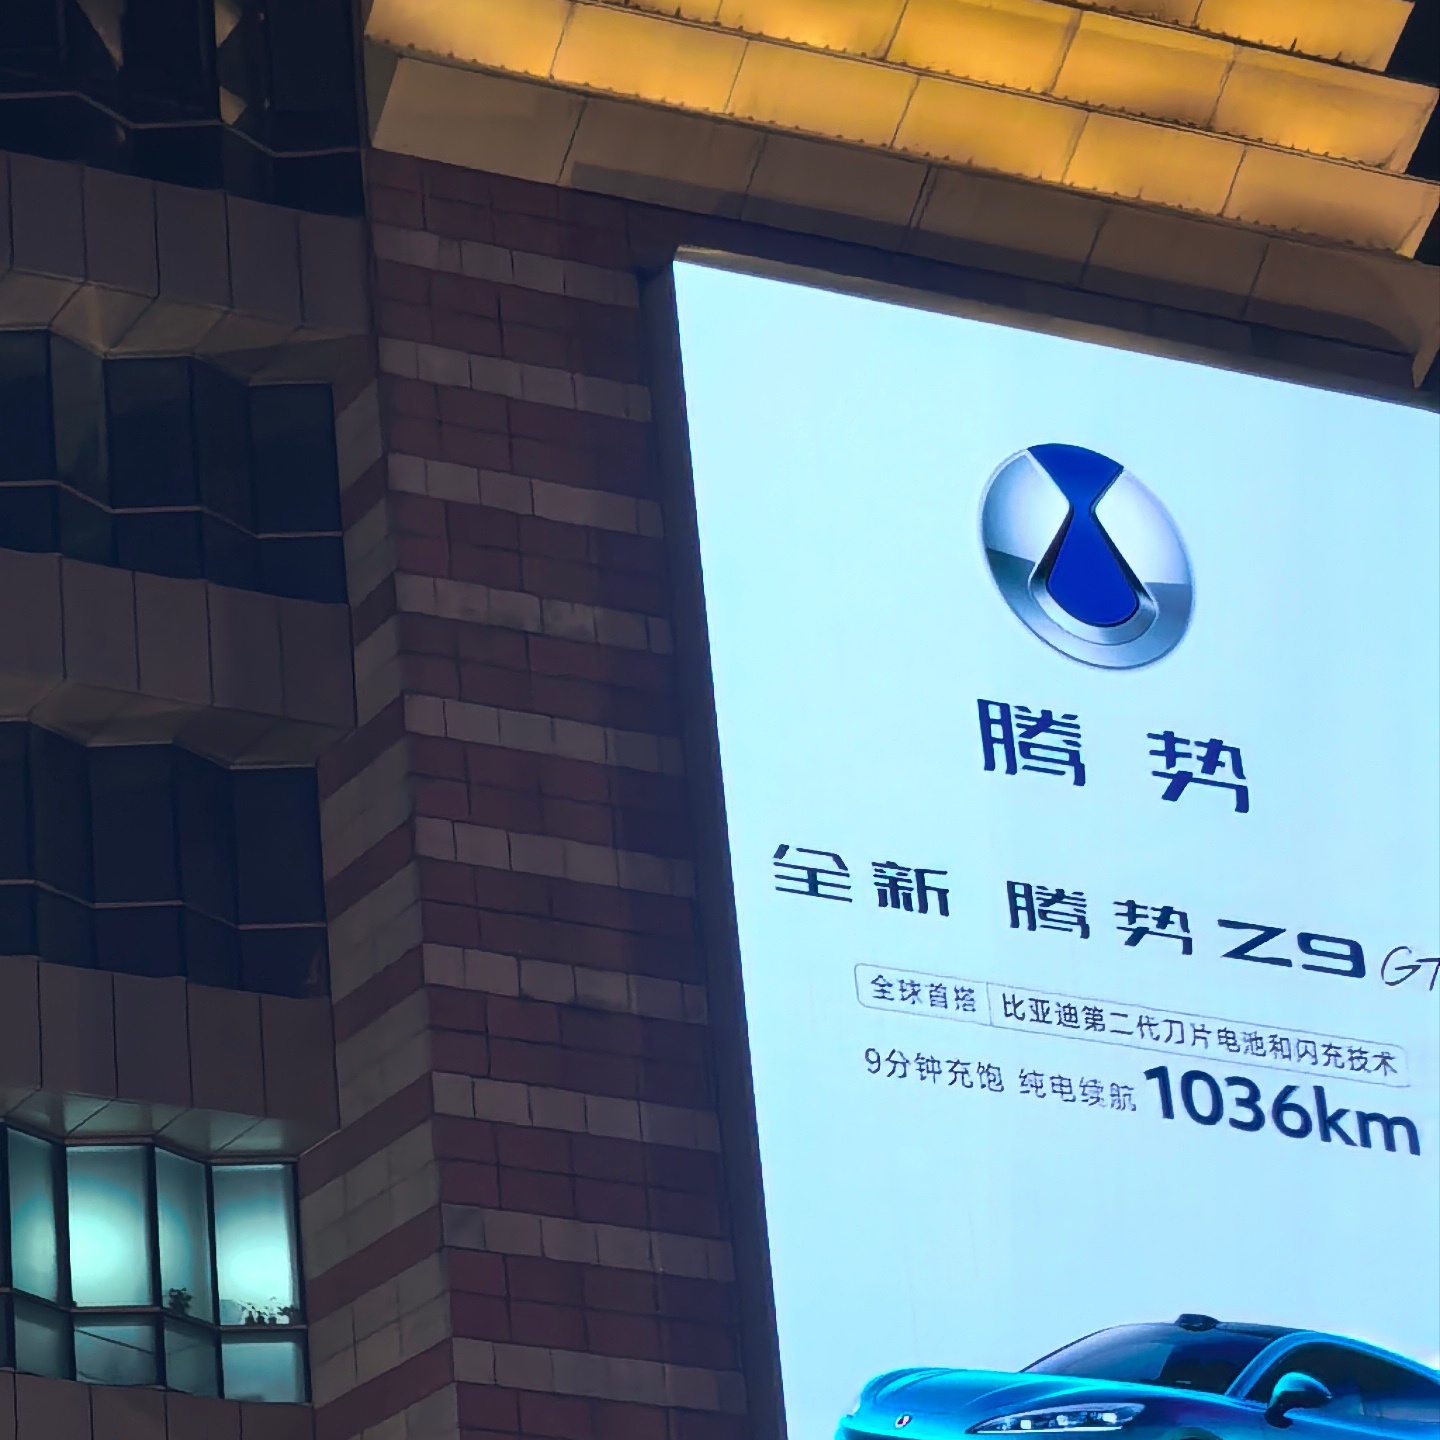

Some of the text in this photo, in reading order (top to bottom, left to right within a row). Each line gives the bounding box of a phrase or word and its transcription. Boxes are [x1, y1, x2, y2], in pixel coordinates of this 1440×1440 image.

[977, 699, 1249, 813] 腾势
[773, 844, 949, 917] 全新
[870, 975, 1398, 1077] 全球首搭 比亚迪第二代刀片电池和闪充技术
[864, 1048, 1421, 1157] 9分钟充饱 纯电续航 1036km
